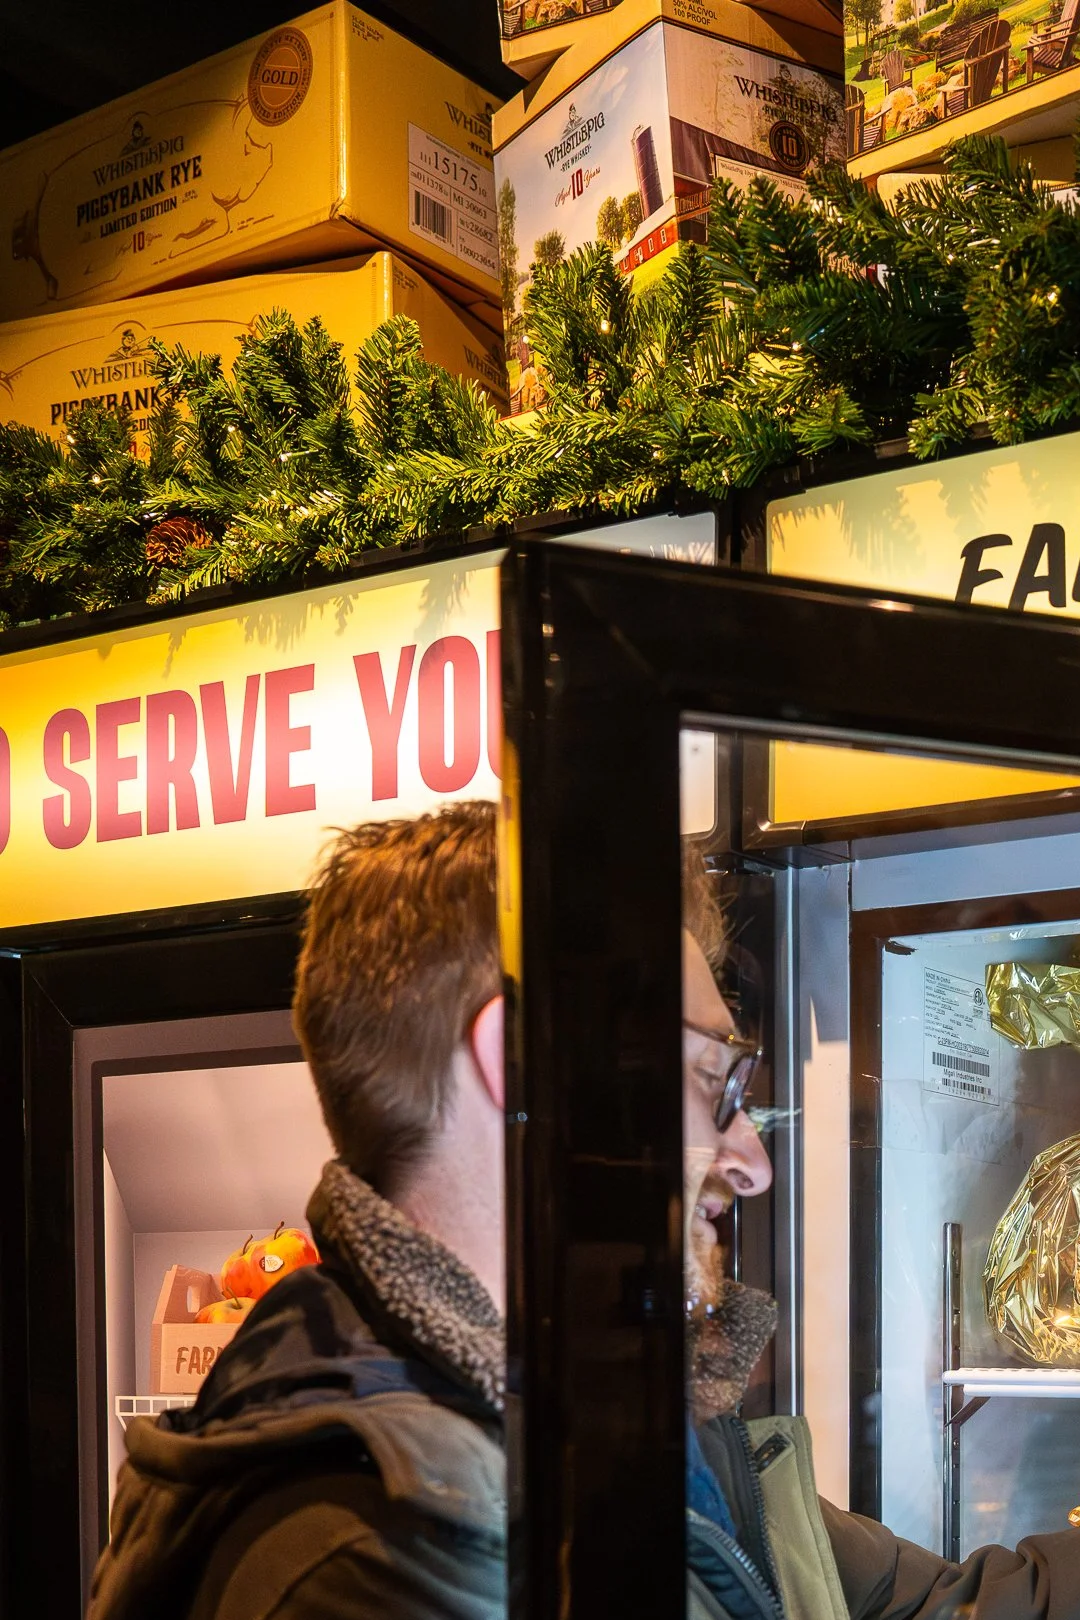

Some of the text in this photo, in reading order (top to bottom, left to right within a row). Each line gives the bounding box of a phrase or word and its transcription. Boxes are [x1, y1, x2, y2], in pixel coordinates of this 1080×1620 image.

[686, 12, 711, 25] PROOF
[262, 69, 298, 85] GOLD
[76, 155, 203, 227] PIGGYBANK RYE
[571, 168, 584, 200] 10
[100, 197, 177, 238] LIMITED EDITION
[132, 231, 145, 253] 10
[42, 664, 316, 850] SERVE
[352, 629, 504, 802] YO
